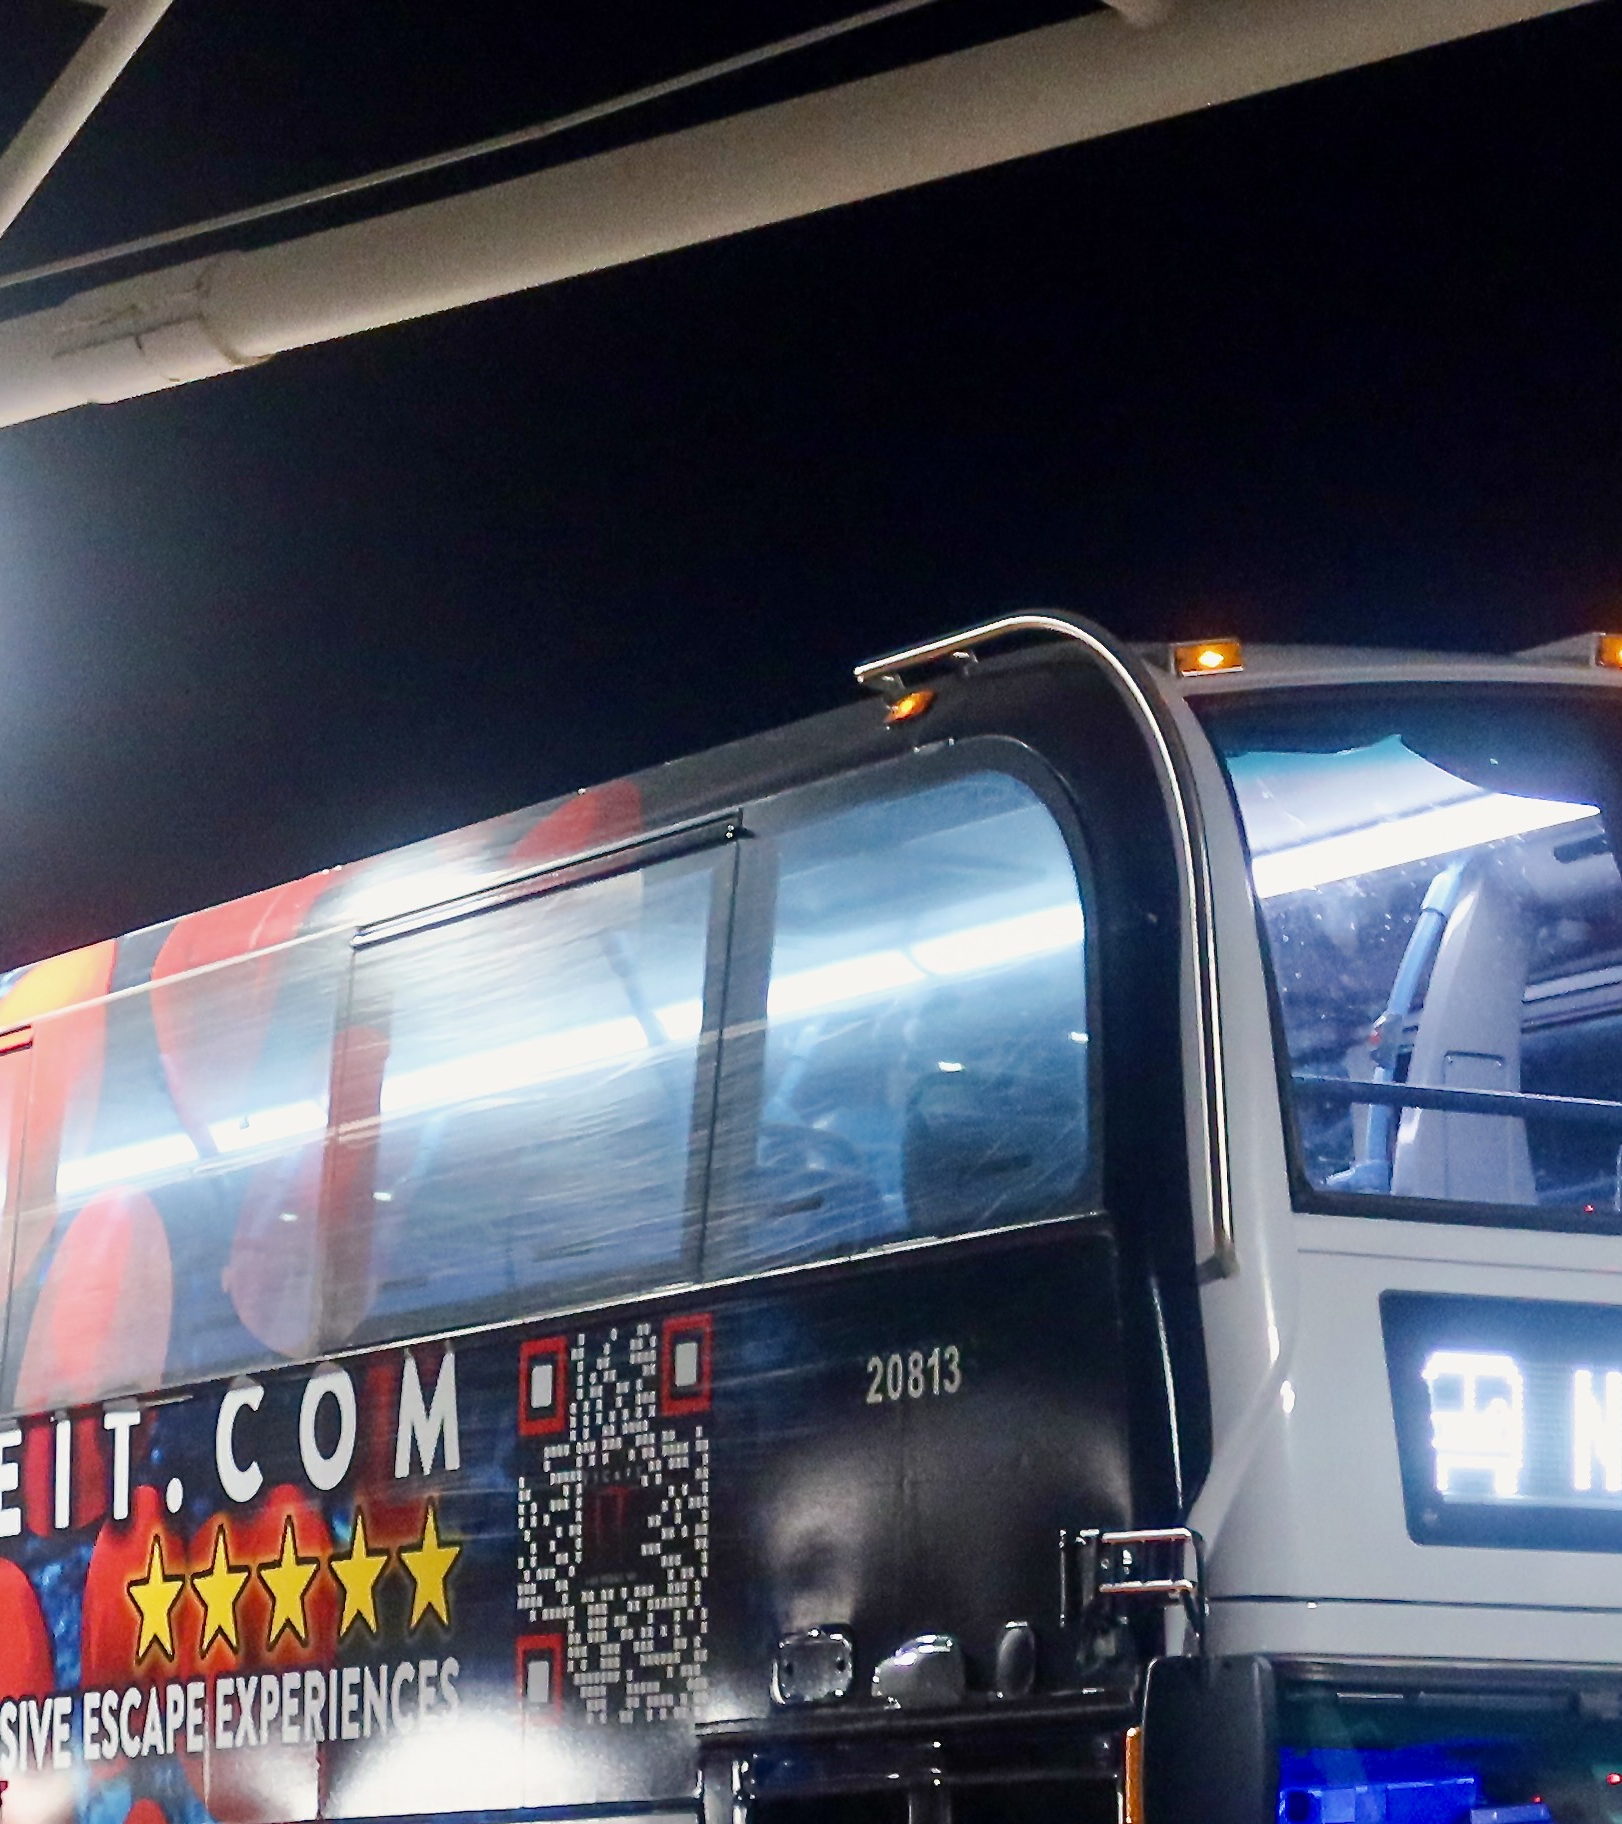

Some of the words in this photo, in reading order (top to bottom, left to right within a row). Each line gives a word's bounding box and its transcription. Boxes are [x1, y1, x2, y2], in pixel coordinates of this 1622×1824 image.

[866, 1345, 962, 1404] 20813
[83, 1682, 206, 1761] ESCAPE
[215, 1656, 461, 1750] EXPERIENCES
